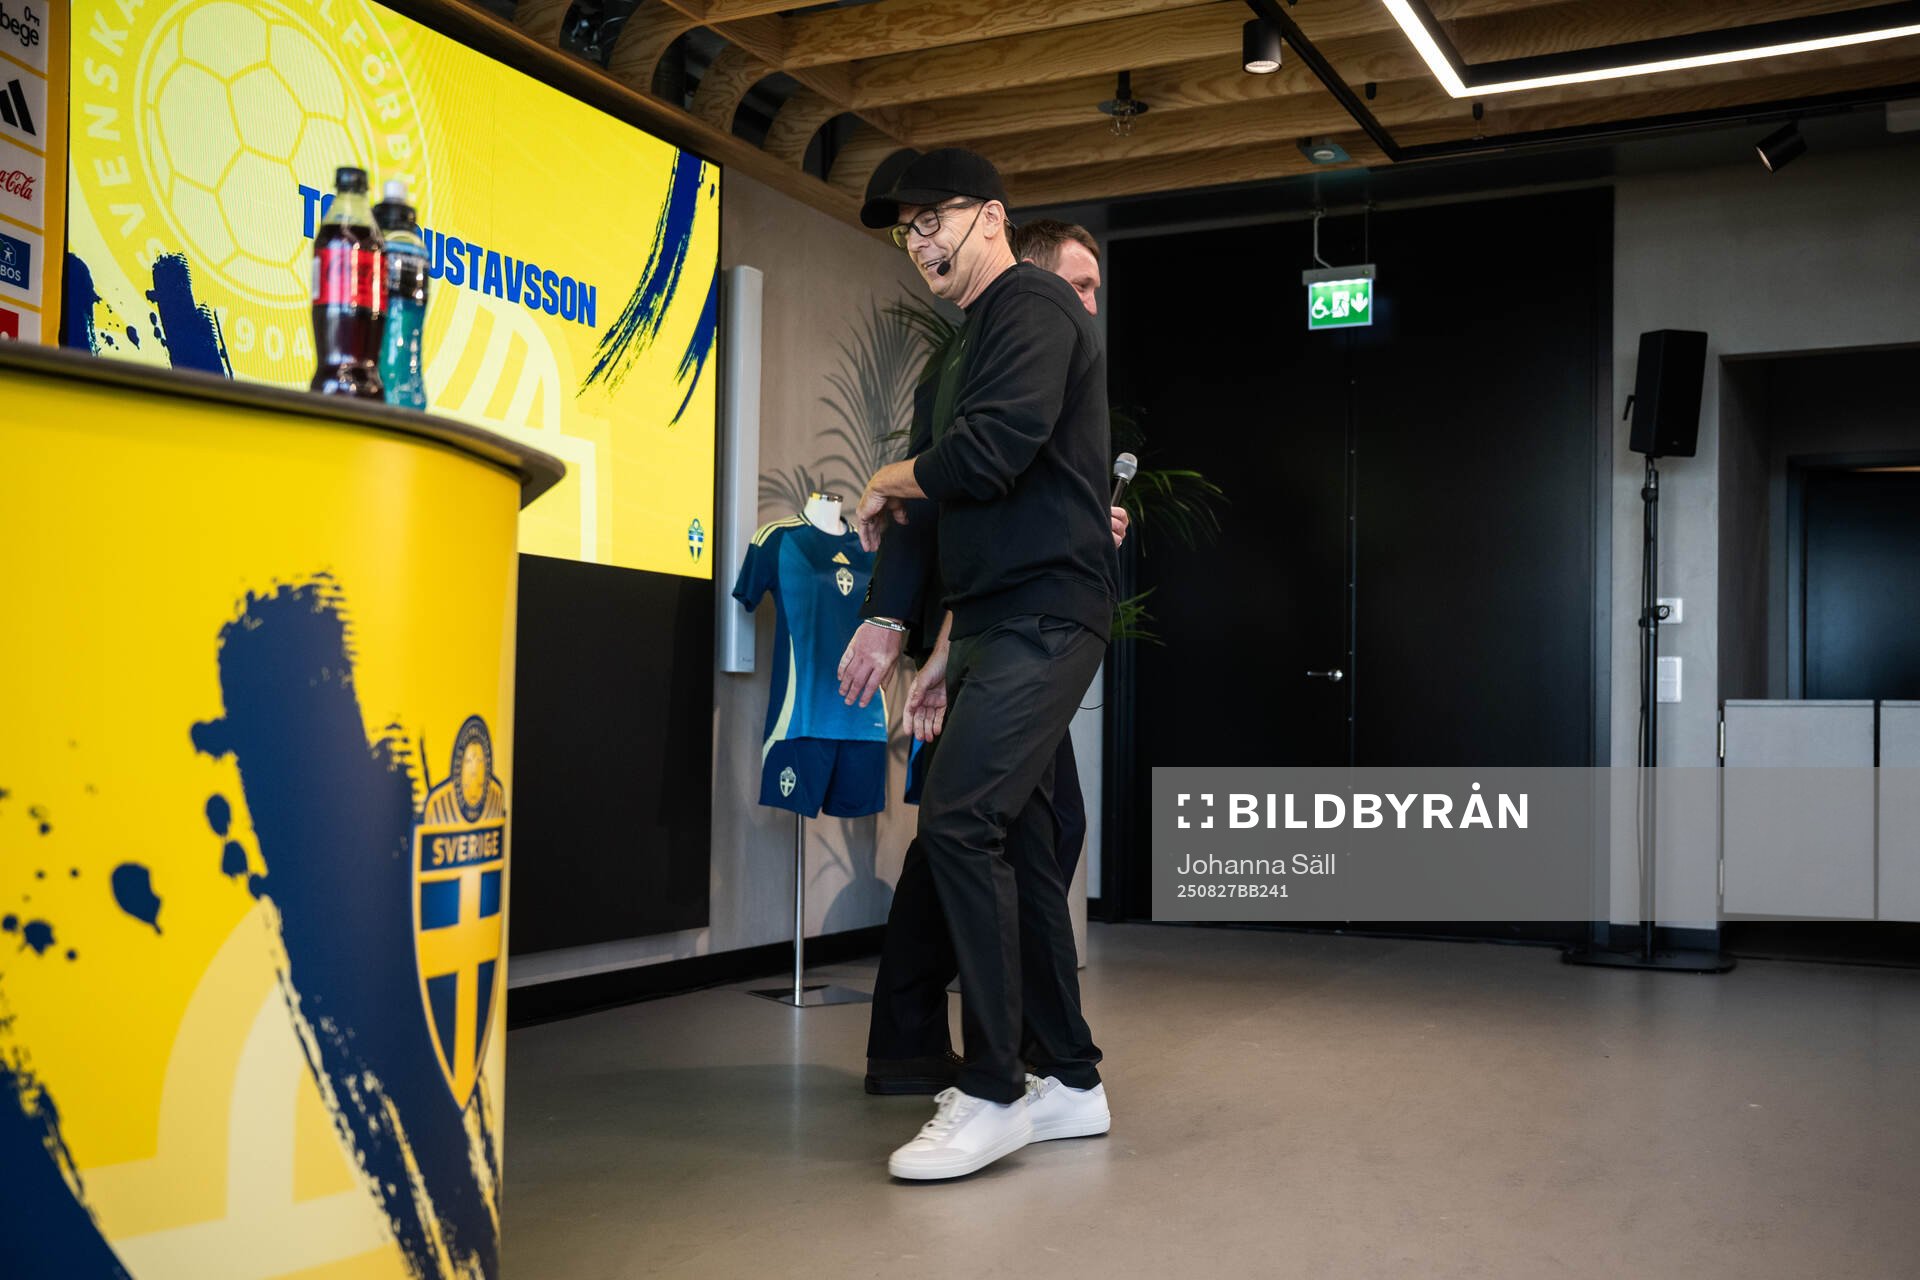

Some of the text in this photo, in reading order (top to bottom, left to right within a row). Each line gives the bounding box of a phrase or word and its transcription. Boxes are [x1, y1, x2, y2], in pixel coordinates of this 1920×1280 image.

[0, 2, 39, 47] bege
[0, 170, 36, 200] a-Cola
[0, 264, 21, 282] BOS
[416, 224, 597, 328] USTAVSSON
[432, 830, 500, 866] SVERIGE
